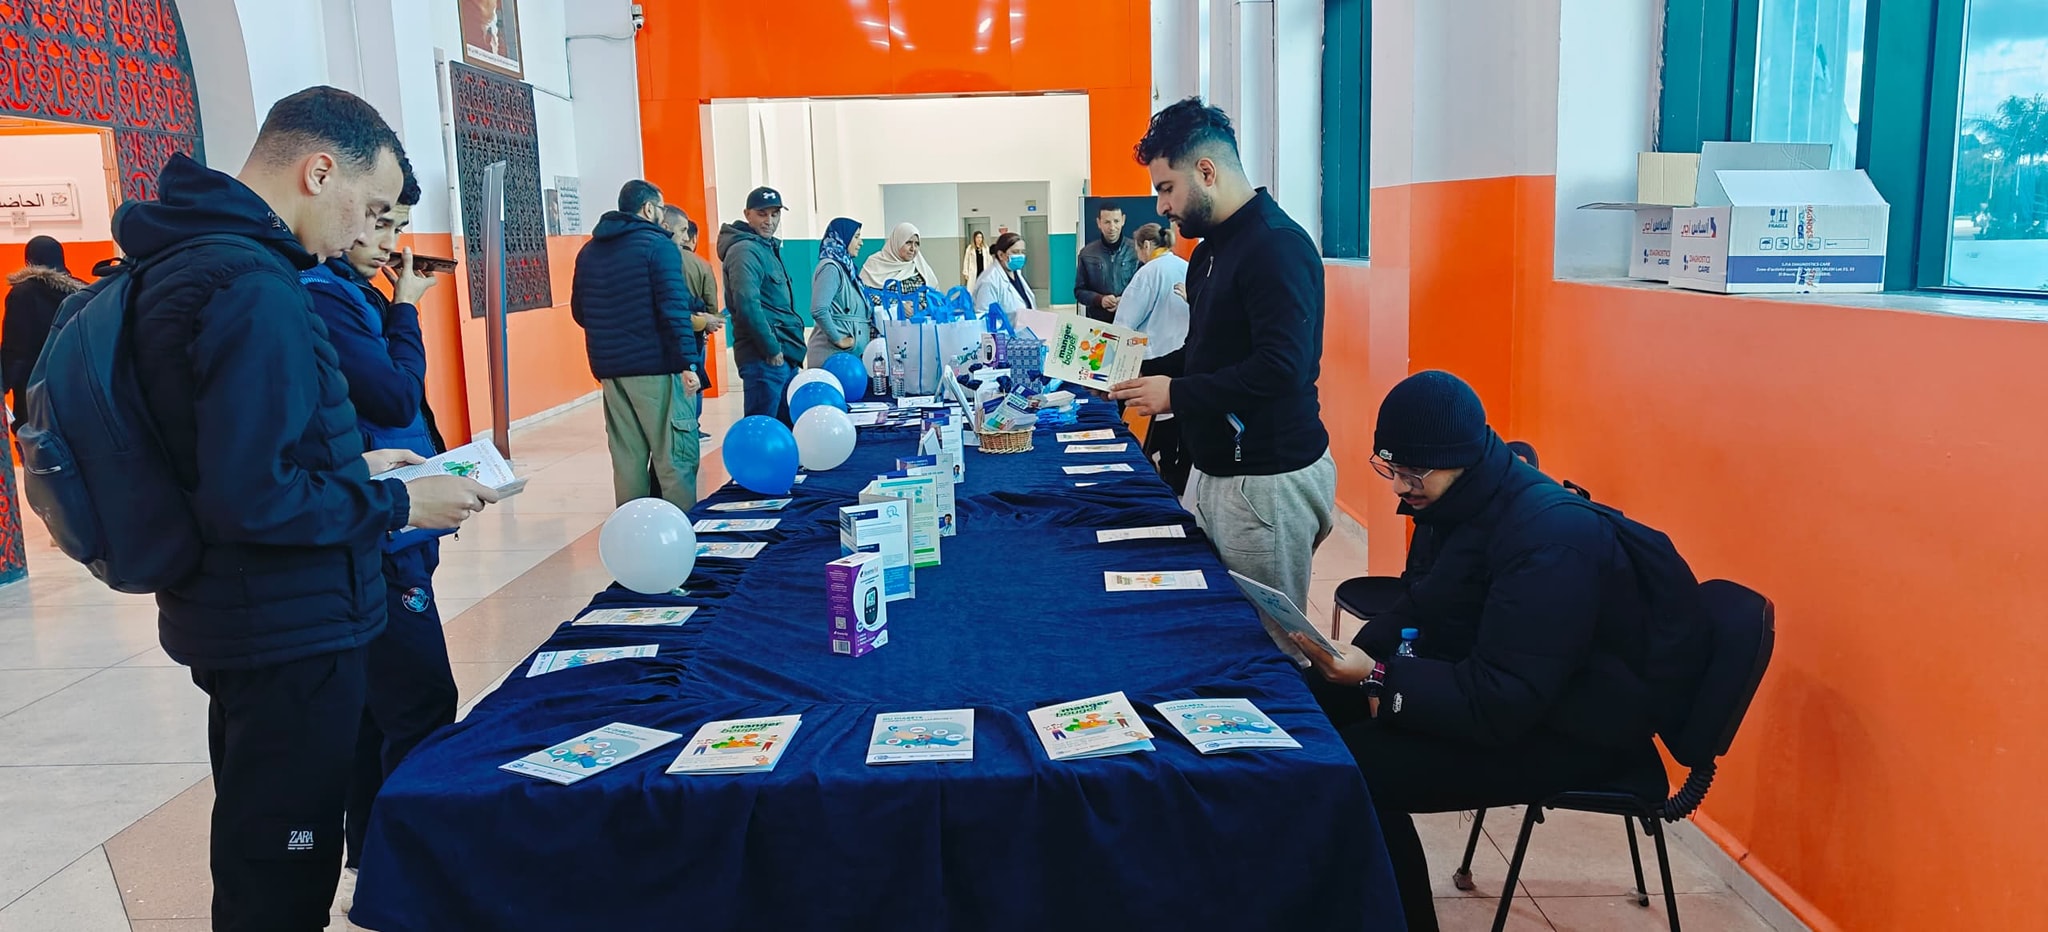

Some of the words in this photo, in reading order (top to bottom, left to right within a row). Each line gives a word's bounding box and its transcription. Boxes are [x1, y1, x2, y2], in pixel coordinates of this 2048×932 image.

[1059, 324, 1072, 359] manger
[1062, 336, 1077, 366] bouger
[1060, 699, 1110, 713] manger
[730, 721, 782, 729] manger
[288, 830, 314, 843] ZARA
